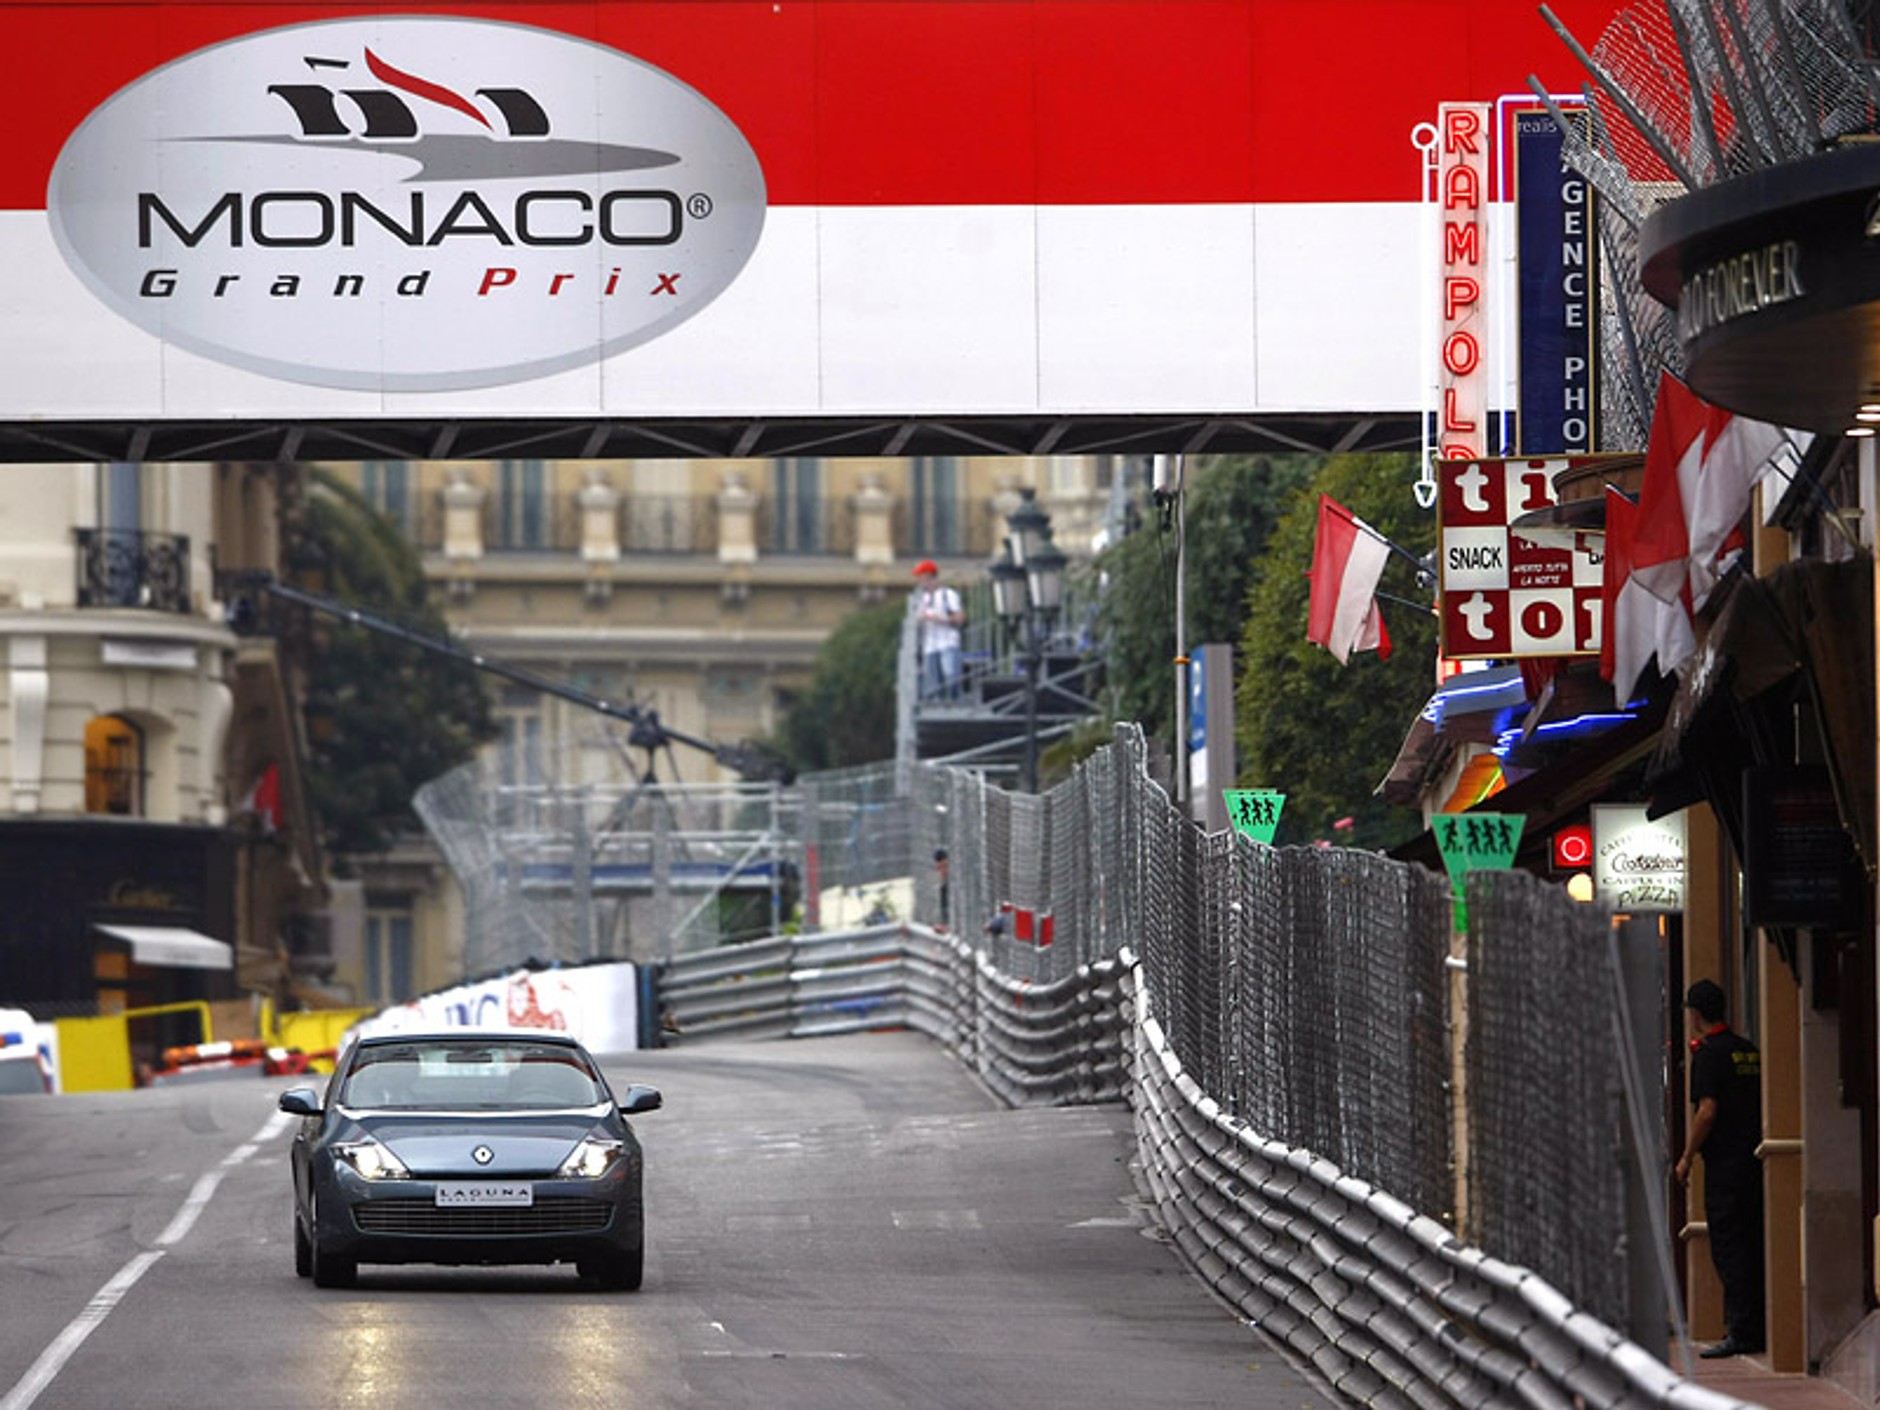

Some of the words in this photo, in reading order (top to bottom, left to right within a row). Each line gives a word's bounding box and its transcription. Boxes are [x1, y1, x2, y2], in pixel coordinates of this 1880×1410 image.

[1560, 160, 1585, 328] GENCE
[139, 268, 432, 298] Grand
[478, 266, 682, 297] Prix
[1563, 356, 1587, 454] PHO
[1453, 458, 1556, 512] ti
[1449, 546, 1503, 570] SNACK
